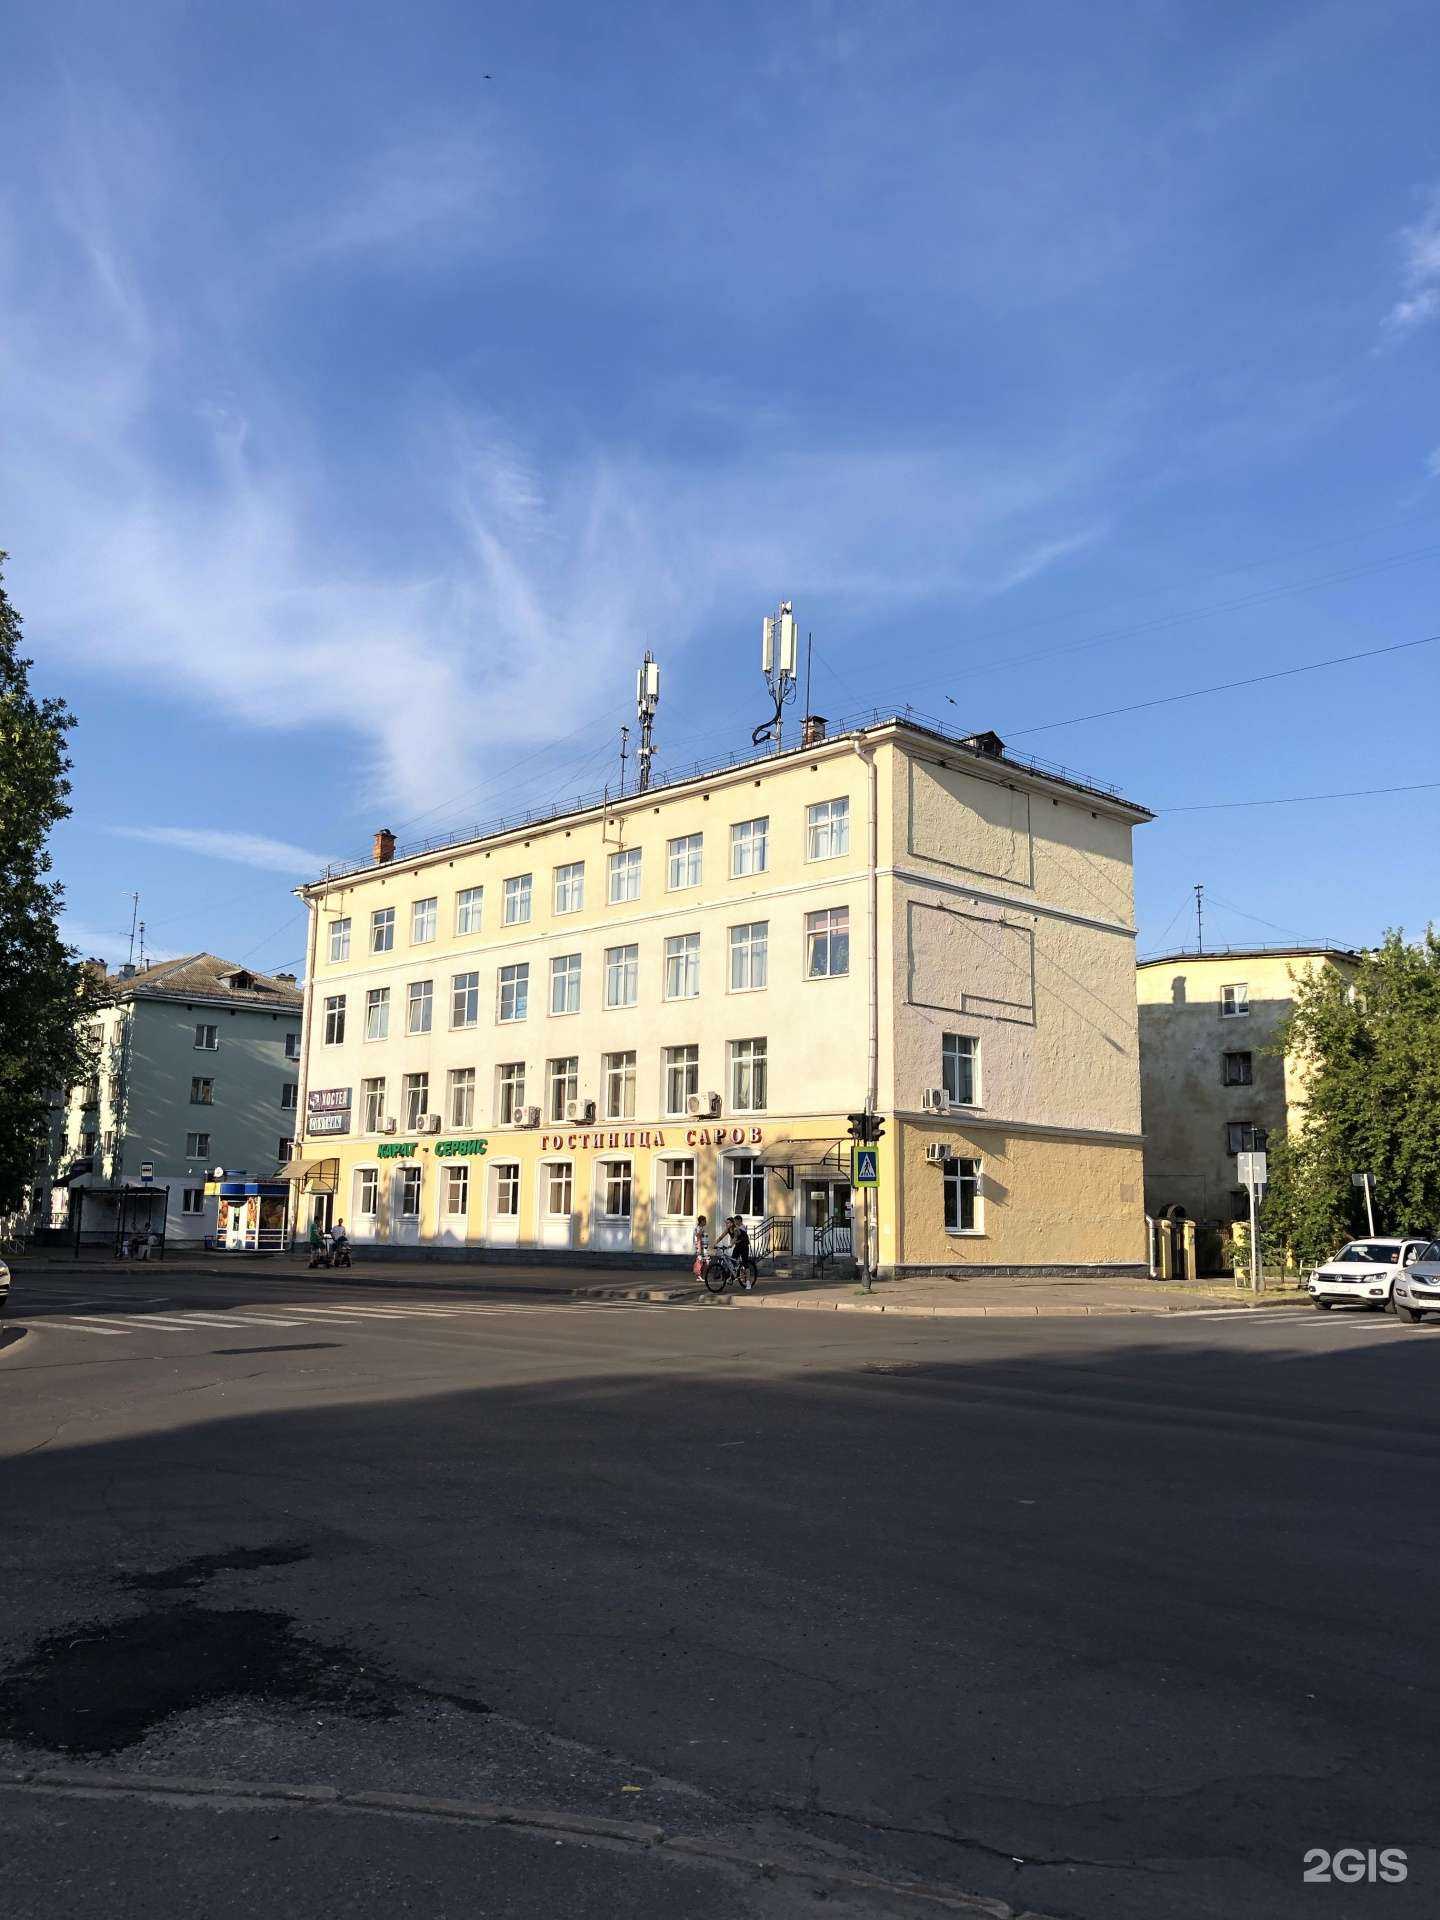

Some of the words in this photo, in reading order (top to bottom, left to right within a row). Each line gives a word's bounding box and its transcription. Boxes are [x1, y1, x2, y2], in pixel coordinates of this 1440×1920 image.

[321, 1091, 348, 1106] ХОСТЕЛ
[377, 1142, 419, 1159] КАРАТ
[435, 1139, 489, 1157] СЕРВИС
[540, 1130, 665, 1151] ГОСТИНИЦА
[686, 1127, 763, 1147] САРОВ
